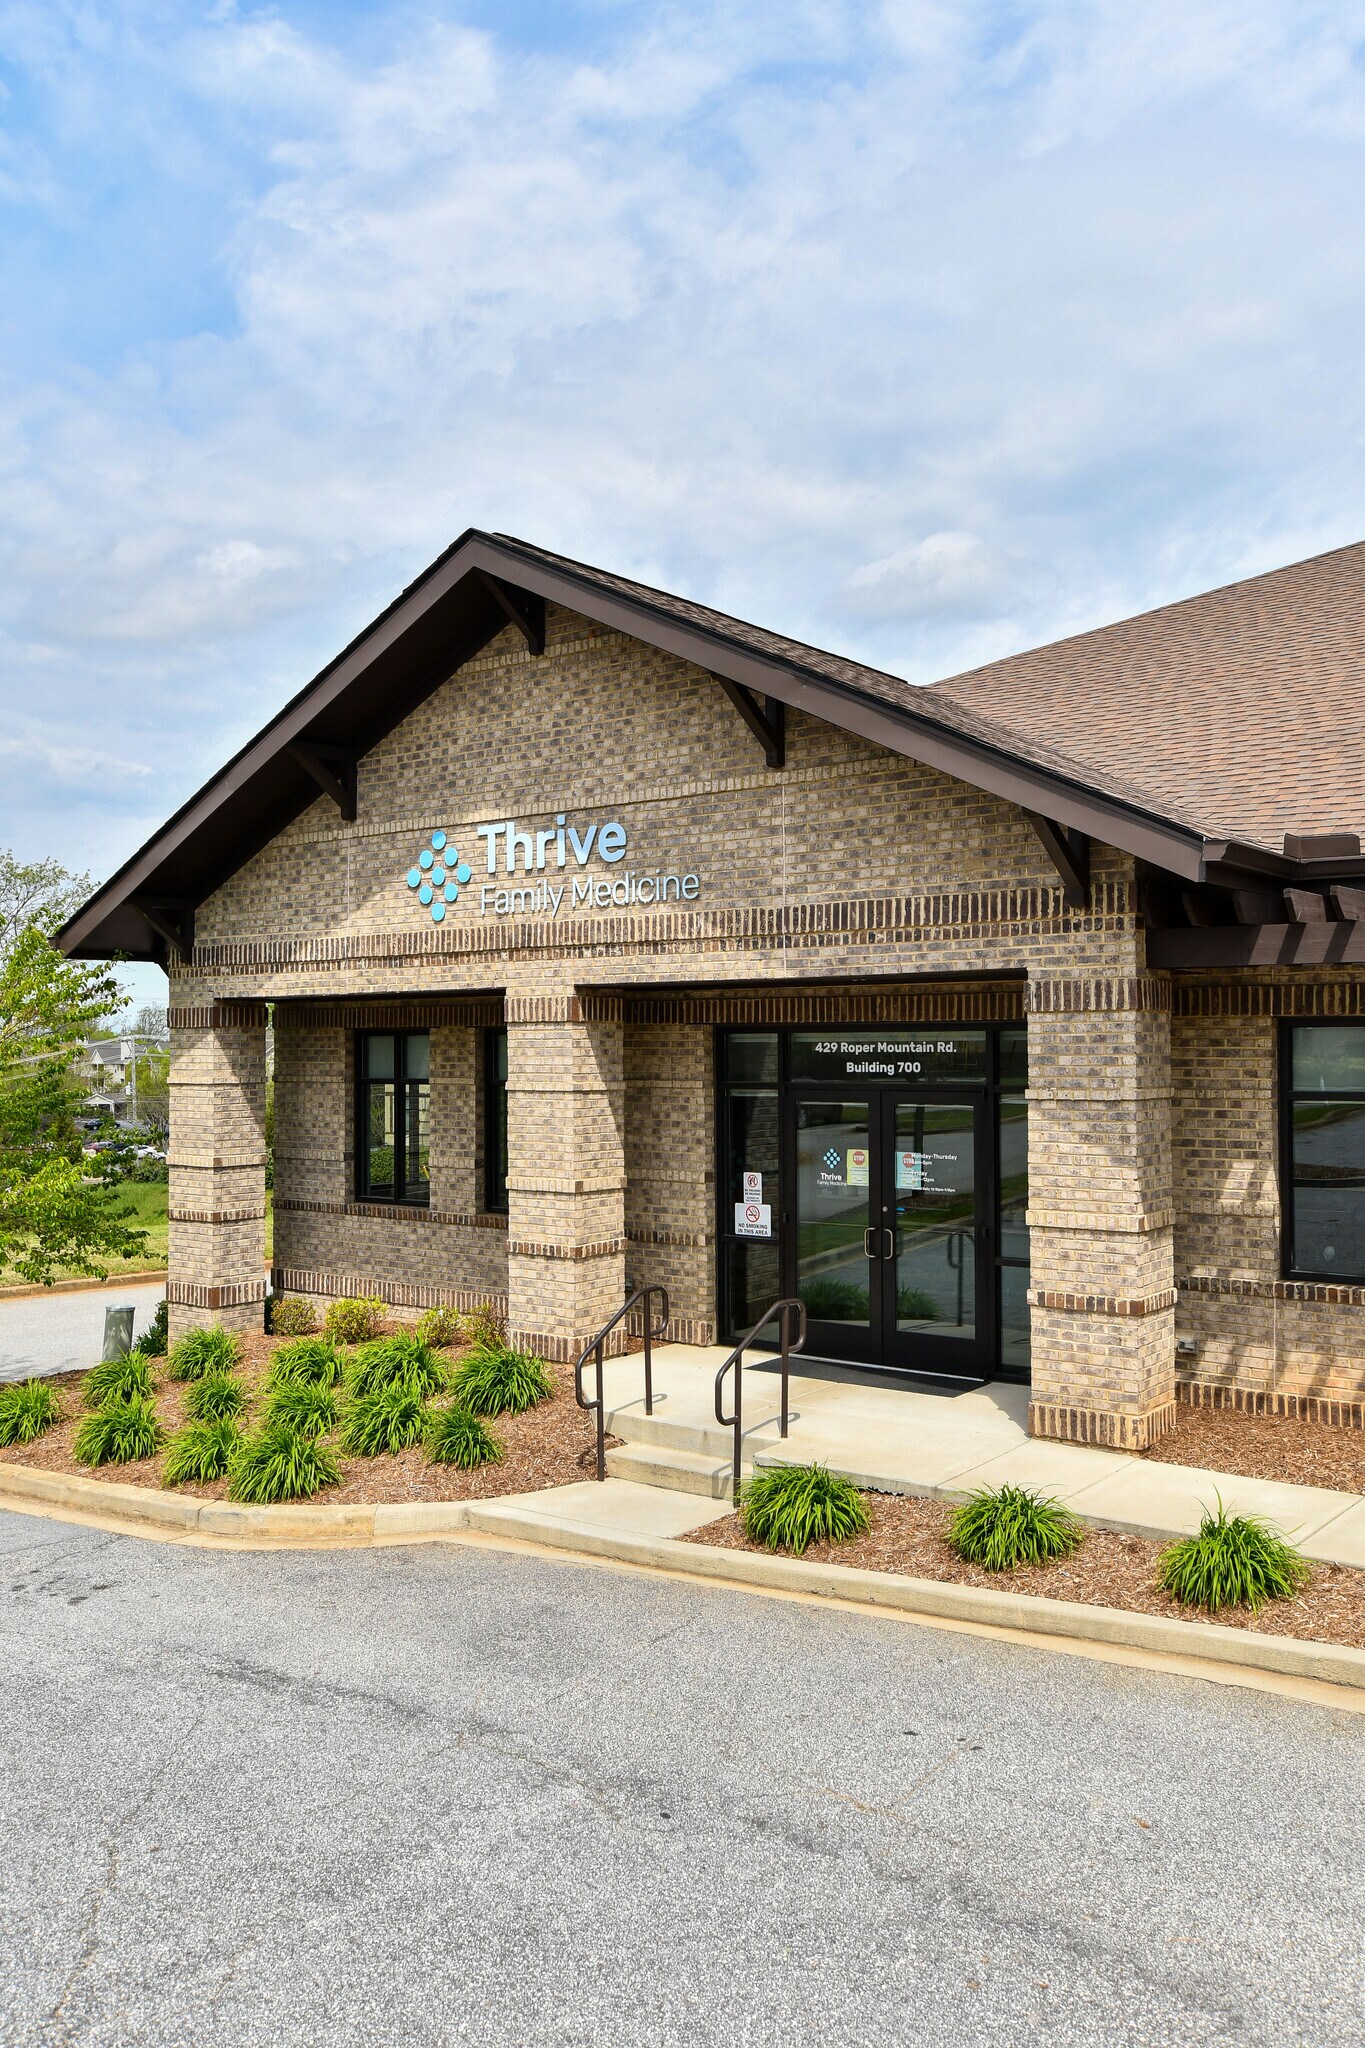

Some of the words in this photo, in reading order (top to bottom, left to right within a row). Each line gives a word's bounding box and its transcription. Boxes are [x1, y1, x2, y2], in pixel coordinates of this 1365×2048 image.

[477, 814, 626, 874] Thrive
[480, 879, 564, 917] Family
[571, 868, 699, 908] Medicine
[815, 1042, 838, 1053] 429
[840, 1042, 875, 1055] Roper
[877, 1041, 934, 1053] Mountain
[937, 1041, 957, 1053] Rd.
[846, 1061, 895, 1076] Building
[897, 1061, 921, 1073] 700
[820, 1172, 842, 1181] Thrive
